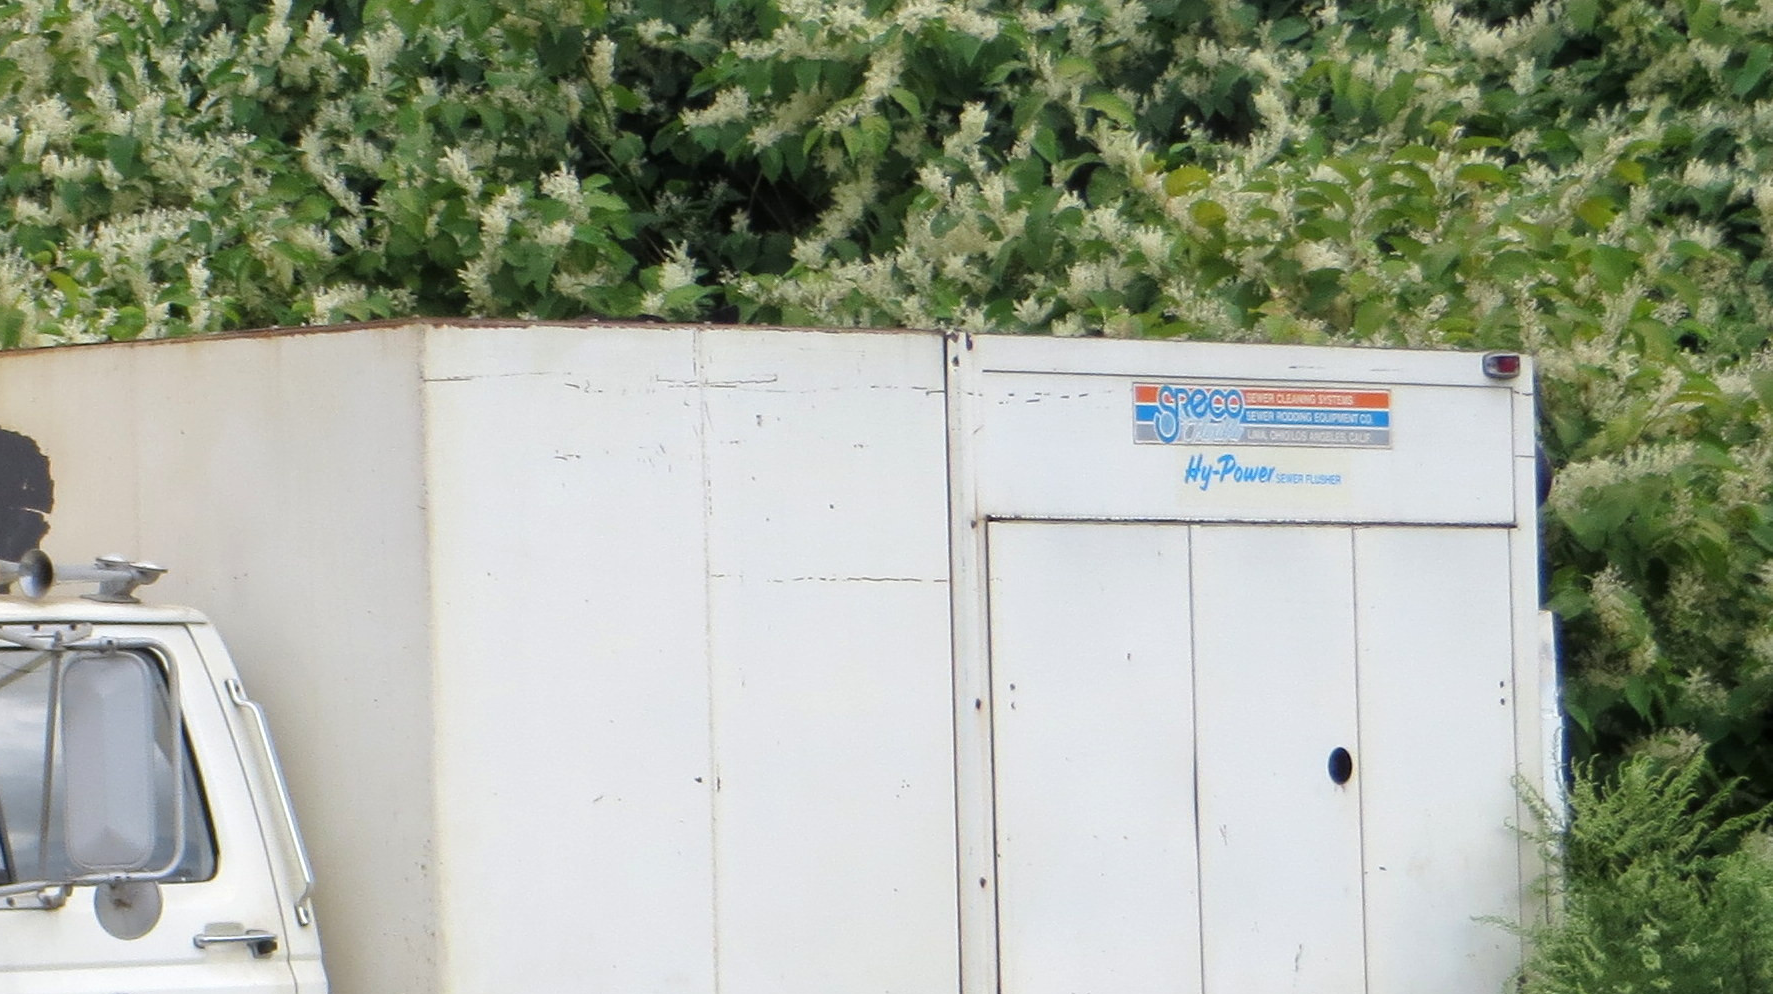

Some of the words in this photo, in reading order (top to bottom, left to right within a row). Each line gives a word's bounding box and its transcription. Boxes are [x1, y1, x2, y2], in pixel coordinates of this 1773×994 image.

[1246, 393, 1275, 403] SEWER
[1276, 393, 1316, 404] CLEANING
[1318, 395, 1354, 405] SYSTEMS
[1246, 411, 1275, 421] SEWER
[1276, 412, 1313, 422] RODDING
[1314, 413, 1359, 423] EQUIPMENT
[1184, 453, 1275, 491] Hy-Power
[1276, 473, 1305, 484] SEWER
[1306, 474, 1342, 485] FLUSHER
